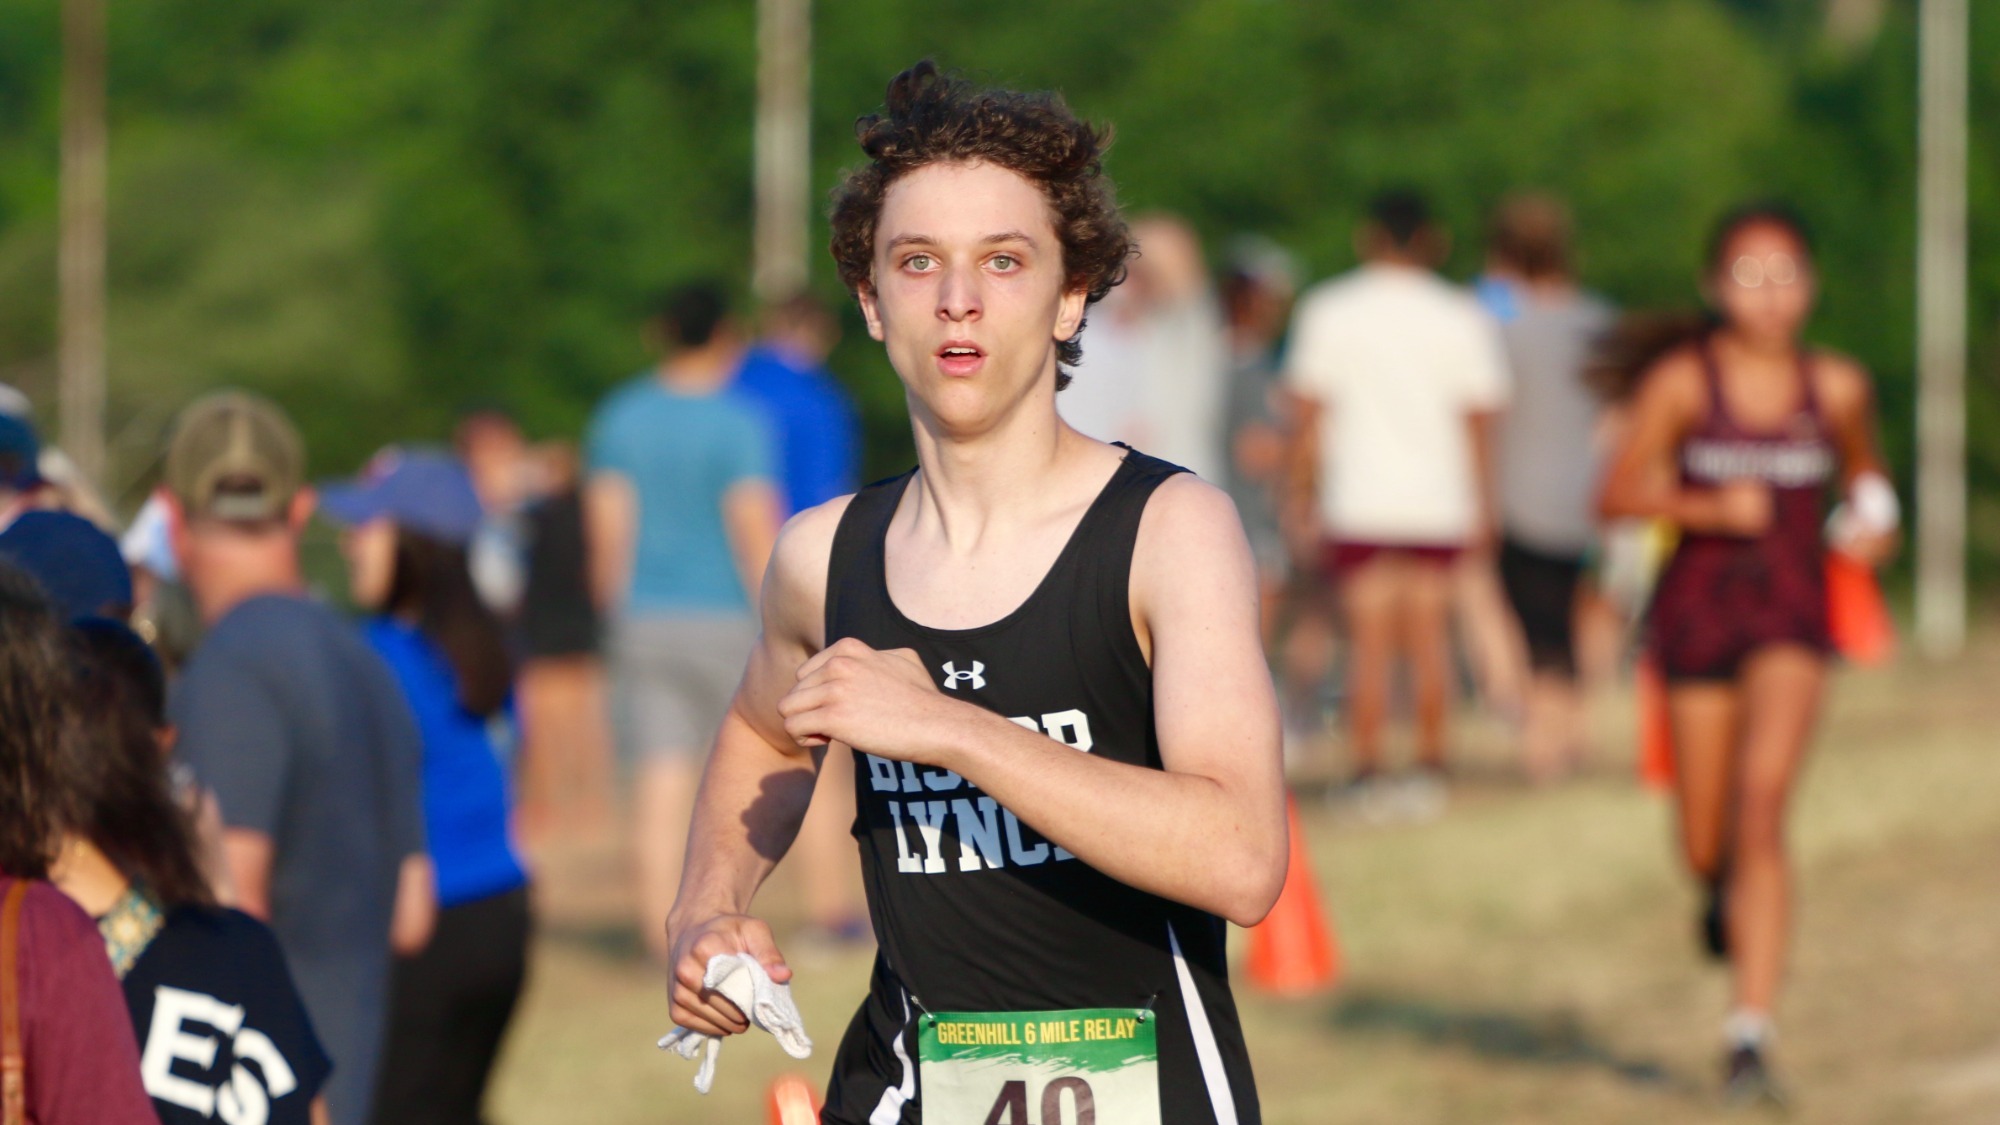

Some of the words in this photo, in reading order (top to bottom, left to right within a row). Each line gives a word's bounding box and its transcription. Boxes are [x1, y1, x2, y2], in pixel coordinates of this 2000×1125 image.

[866, 708, 1094, 793] BISP
[889, 796, 1078, 874] LYNC
[936, 1022, 1021, 1045] GREENHILL
[1024, 1022, 1037, 1045] 6
[1040, 1020, 1080, 1044] MILE
[1084, 1017, 1137, 1041] RELAY
[983, 1076, 1096, 1125] 40
